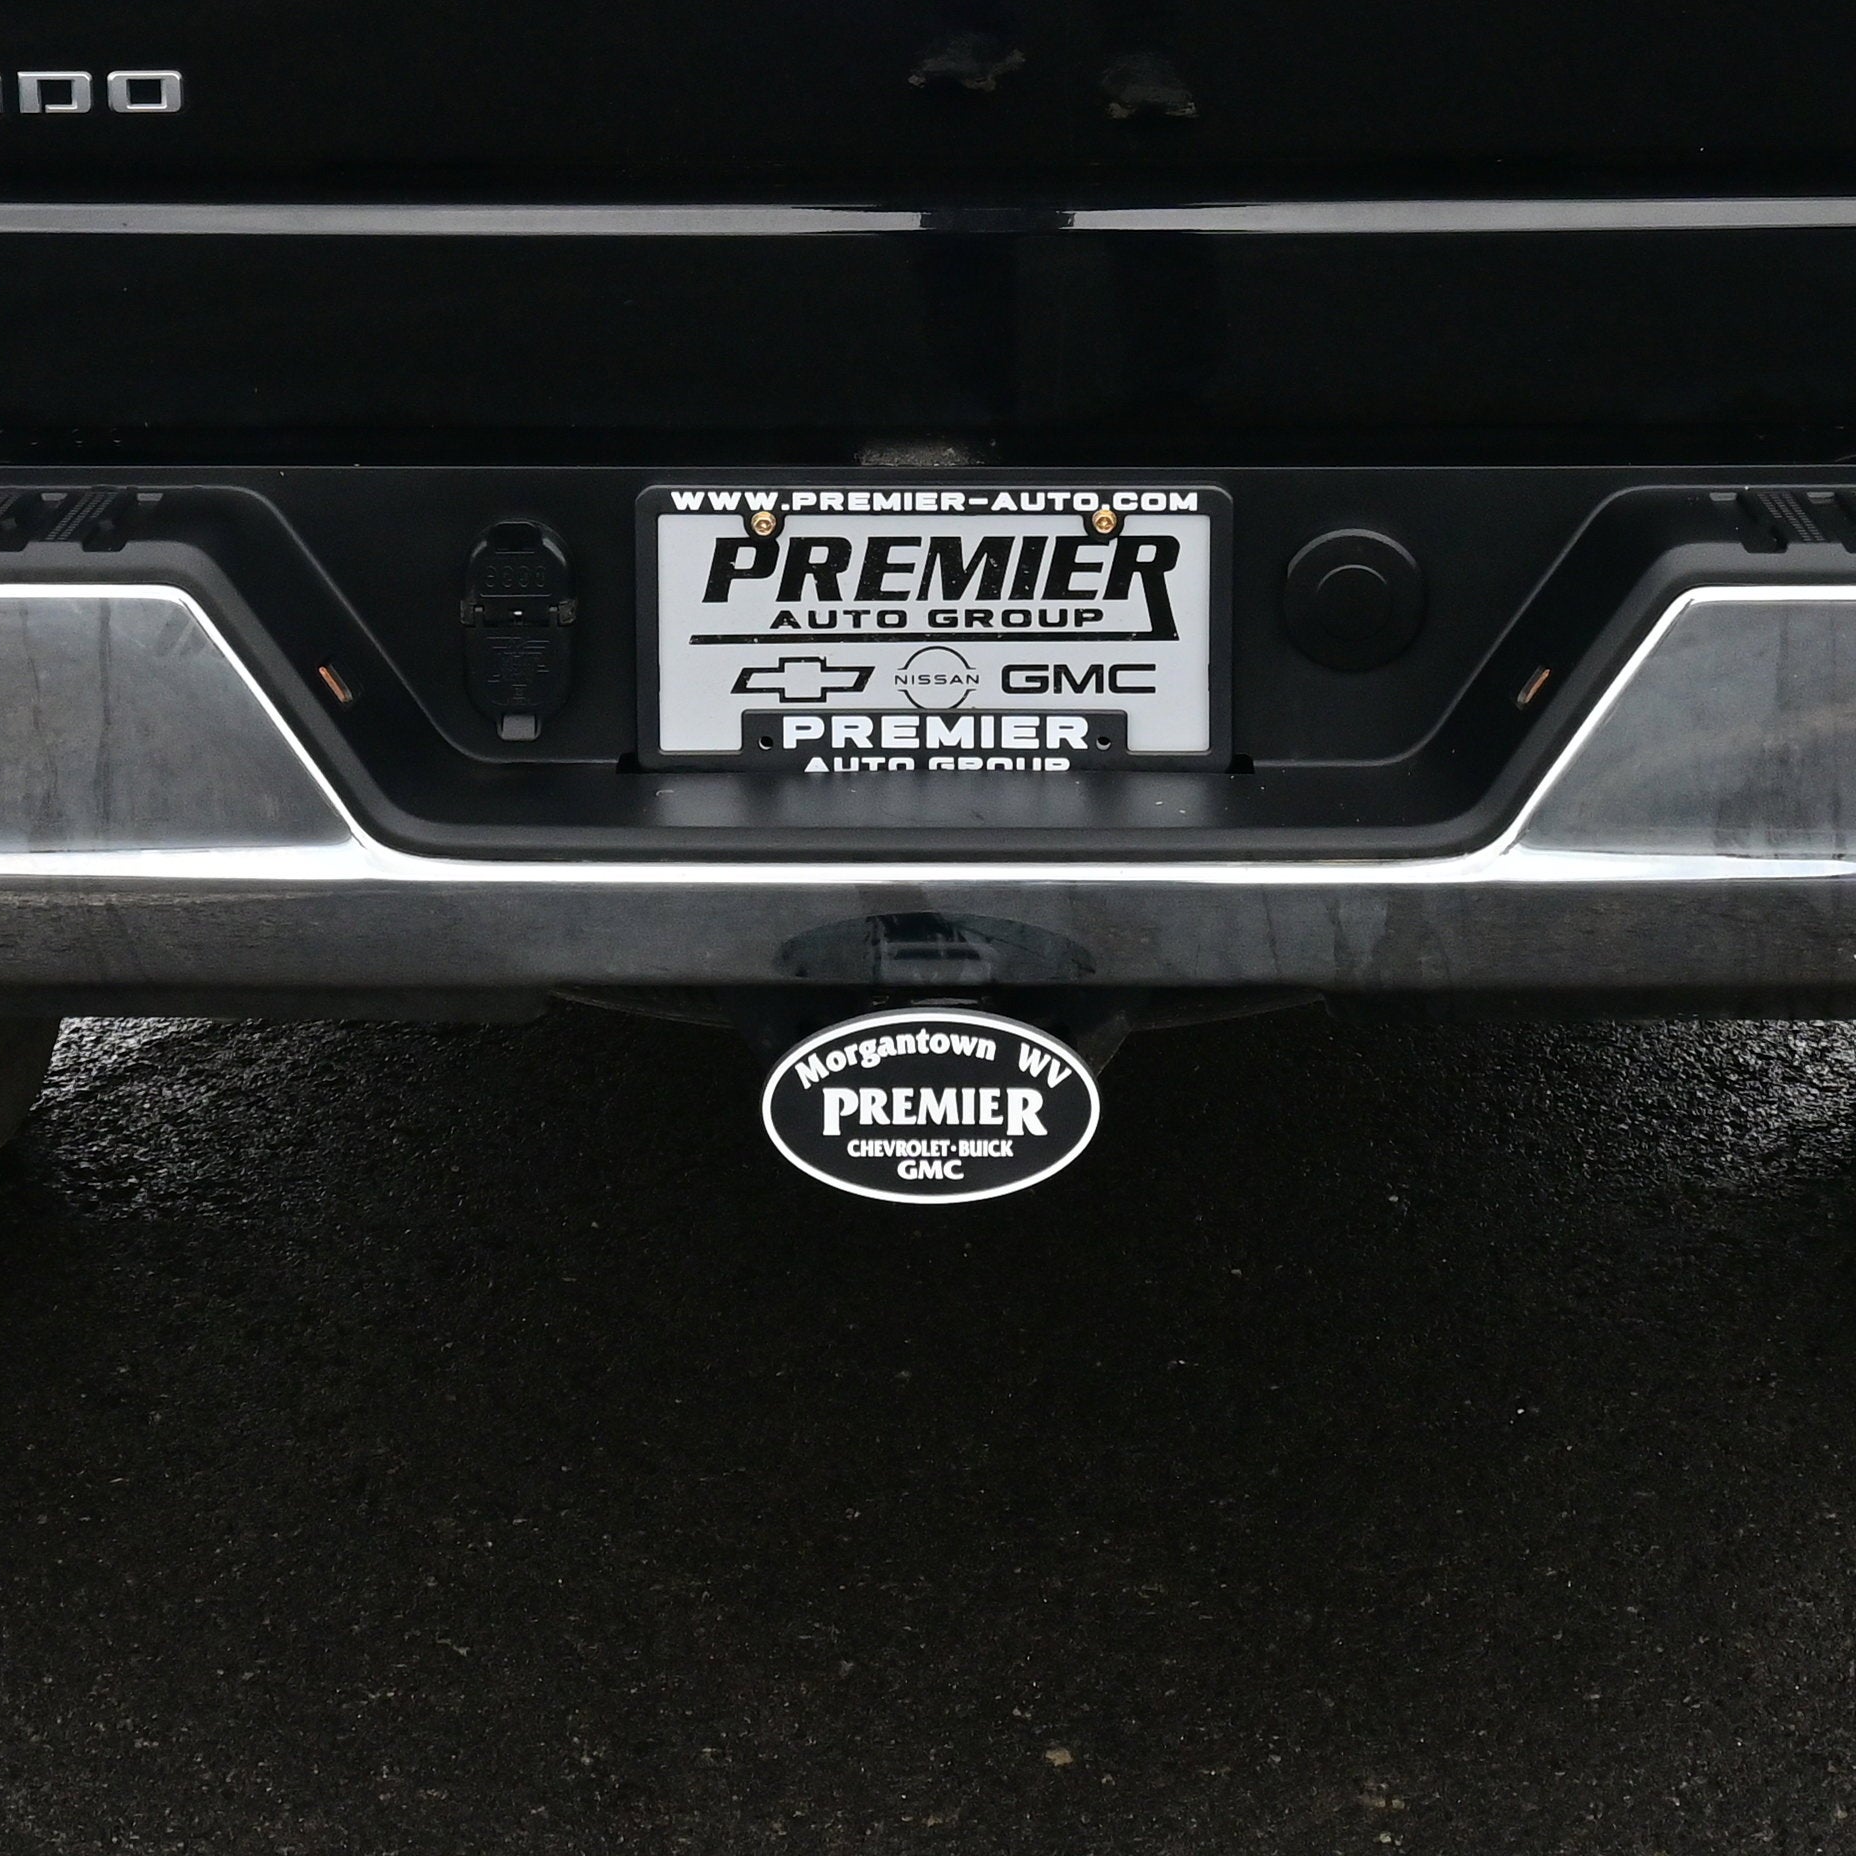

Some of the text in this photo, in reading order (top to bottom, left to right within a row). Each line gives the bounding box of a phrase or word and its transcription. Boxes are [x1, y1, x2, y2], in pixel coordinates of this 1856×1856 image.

[670, 491, 1199, 513] WWW.PREMIER-AUTO.COM
[701, 535, 1181, 604] PREMIER
[769, 608, 1105, 630] AUTO GROUP
[894, 673, 981, 687] NISSAN
[1000, 663, 1157, 696] GMC
[781, 715, 1090, 751] PREMIER
[803, 756, 916, 773] AUTO
[794, 1028, 1073, 1090] Morgantown WV
[821, 1087, 1049, 1137] PREMIER
[896, 1159, 966, 1181] GMC
